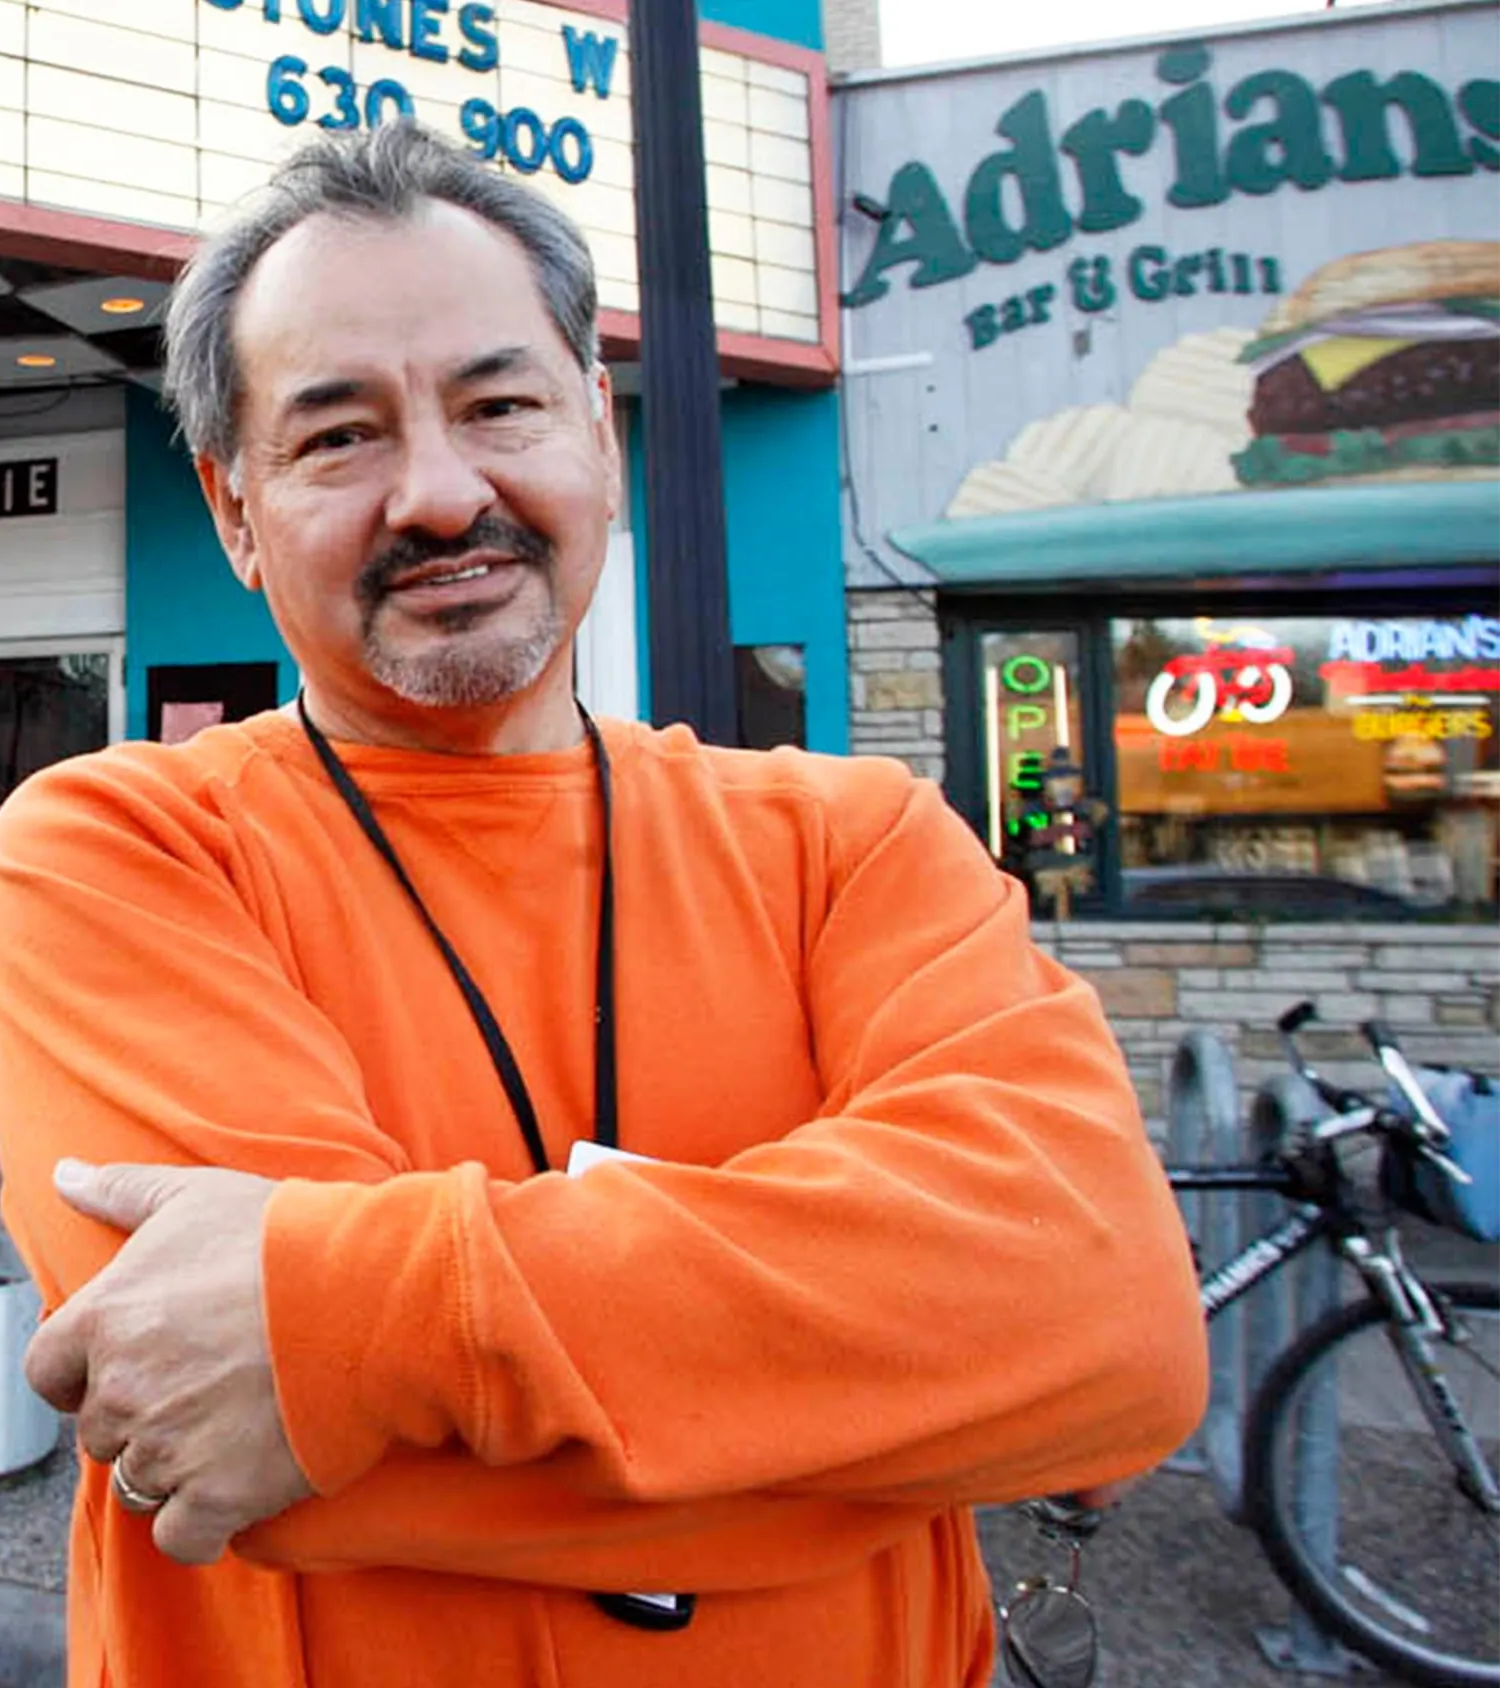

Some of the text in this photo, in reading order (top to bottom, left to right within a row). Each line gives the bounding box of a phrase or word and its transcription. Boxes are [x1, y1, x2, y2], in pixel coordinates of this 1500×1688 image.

[266, 55, 593, 184] 630 900
[561, 24, 617, 99] W
[839, 44, 1500, 308] Adrians
[963, 245, 1283, 351] Bar & Grill
